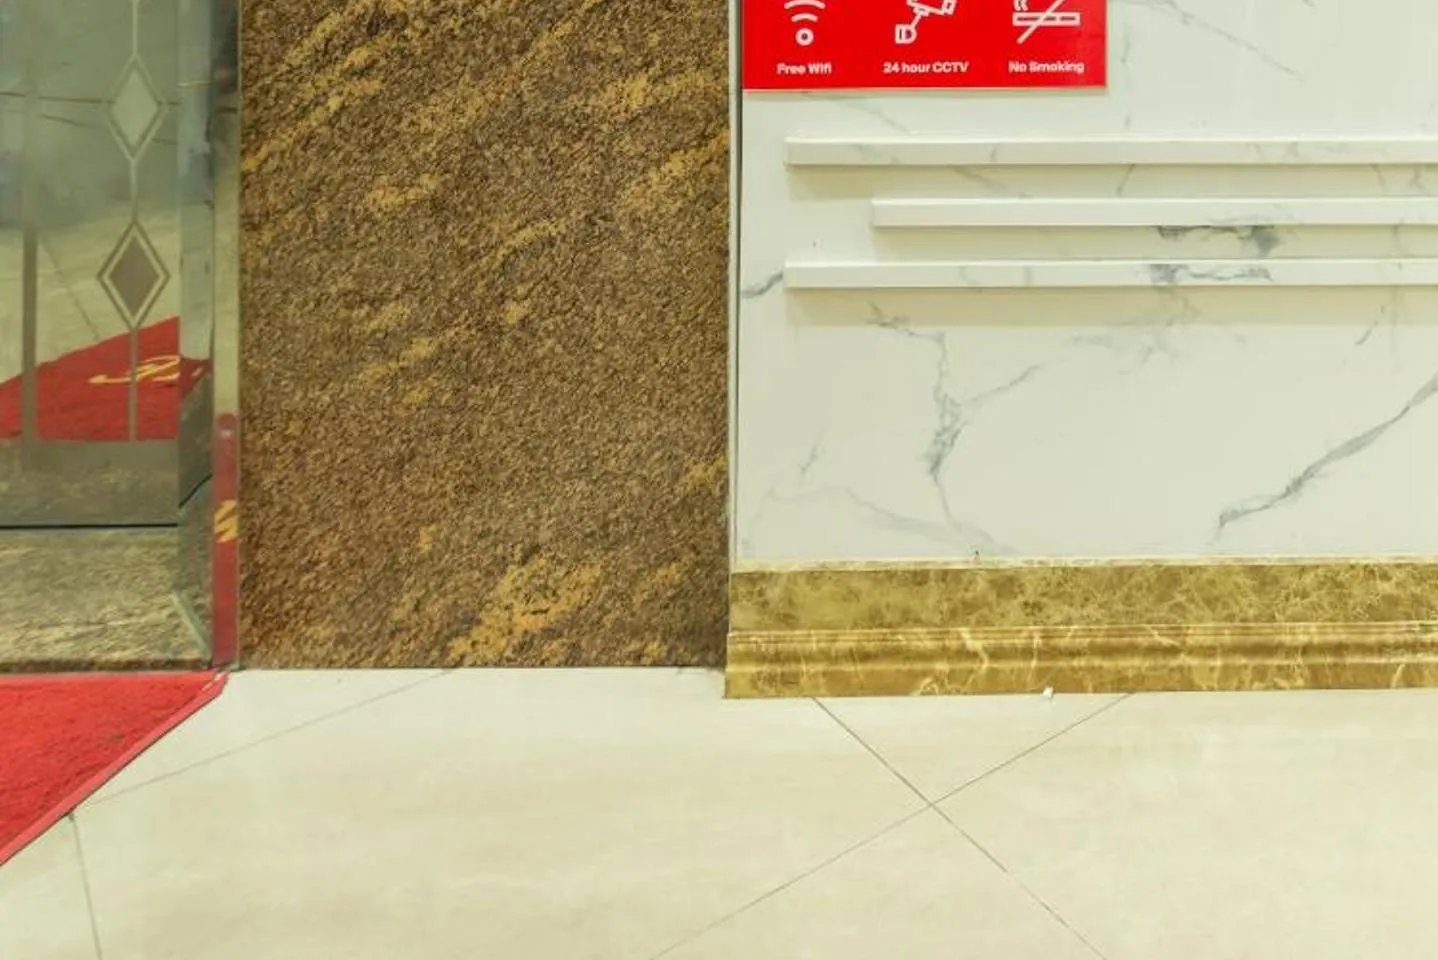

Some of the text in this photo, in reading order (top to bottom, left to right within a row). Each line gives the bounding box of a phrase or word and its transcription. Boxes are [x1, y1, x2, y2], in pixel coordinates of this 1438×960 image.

[776, 62, 805, 75] Free
[883, 61, 970, 74] 24 hour CCTV
[1008, 60, 1085, 75] No Smoking
